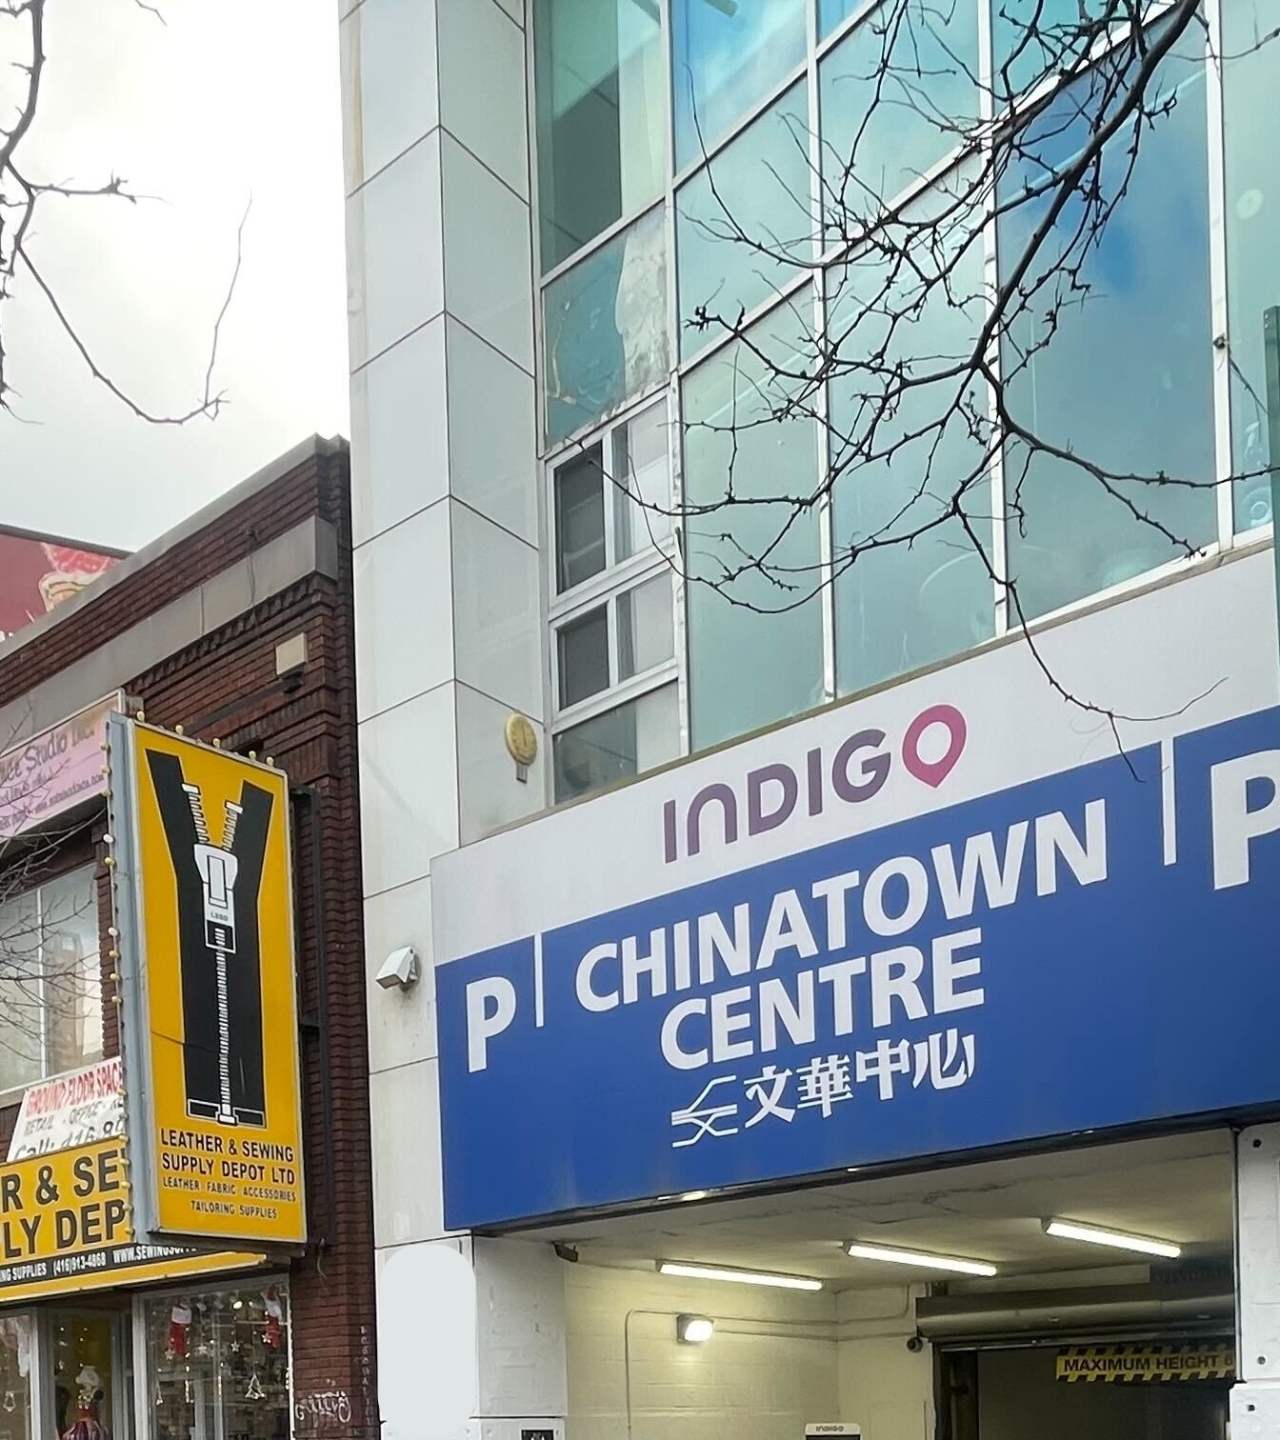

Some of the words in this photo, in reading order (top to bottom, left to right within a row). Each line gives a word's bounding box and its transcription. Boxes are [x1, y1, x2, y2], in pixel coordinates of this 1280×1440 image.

[24, 731, 68, 773] Studio
[664, 703, 967, 864] INDIGO
[466, 976, 517, 1074] P
[575, 798, 1107, 1013] CHINATOWN
[660, 927, 984, 1071] CENTRE
[26, 1081, 66, 1117] GROUND
[68, 1071, 95, 1106] FLOOR
[161, 1128, 223, 1154] LEATHER
[229, 1139, 238, 1155] &
[242, 1141, 294, 1163] SEWING
[36, 1165, 59, 1205] &
[73, 1148, 125, 1197] SE
[162, 1152, 214, 1176] SUPPLY
[221, 1160, 266, 1182] DEPOT
[271, 1167, 296, 1186] LTD
[163, 1176, 200, 1191] LEATHER
[207, 1181, 236, 1195] FABRIC
[243, 1187, 296, 1202] ACCESSORIES
[55, 1199, 126, 1249] DEP
[191, 1200, 235, 1215] TAILORING
[239, 1205, 278, 1220] SUPPLIES
[12, 1262, 47, 1282] SUPPLIES
[1064, 1357, 1151, 1373] MAXIMUM
[1156, 1354, 1219, 1369] HEIGHT
